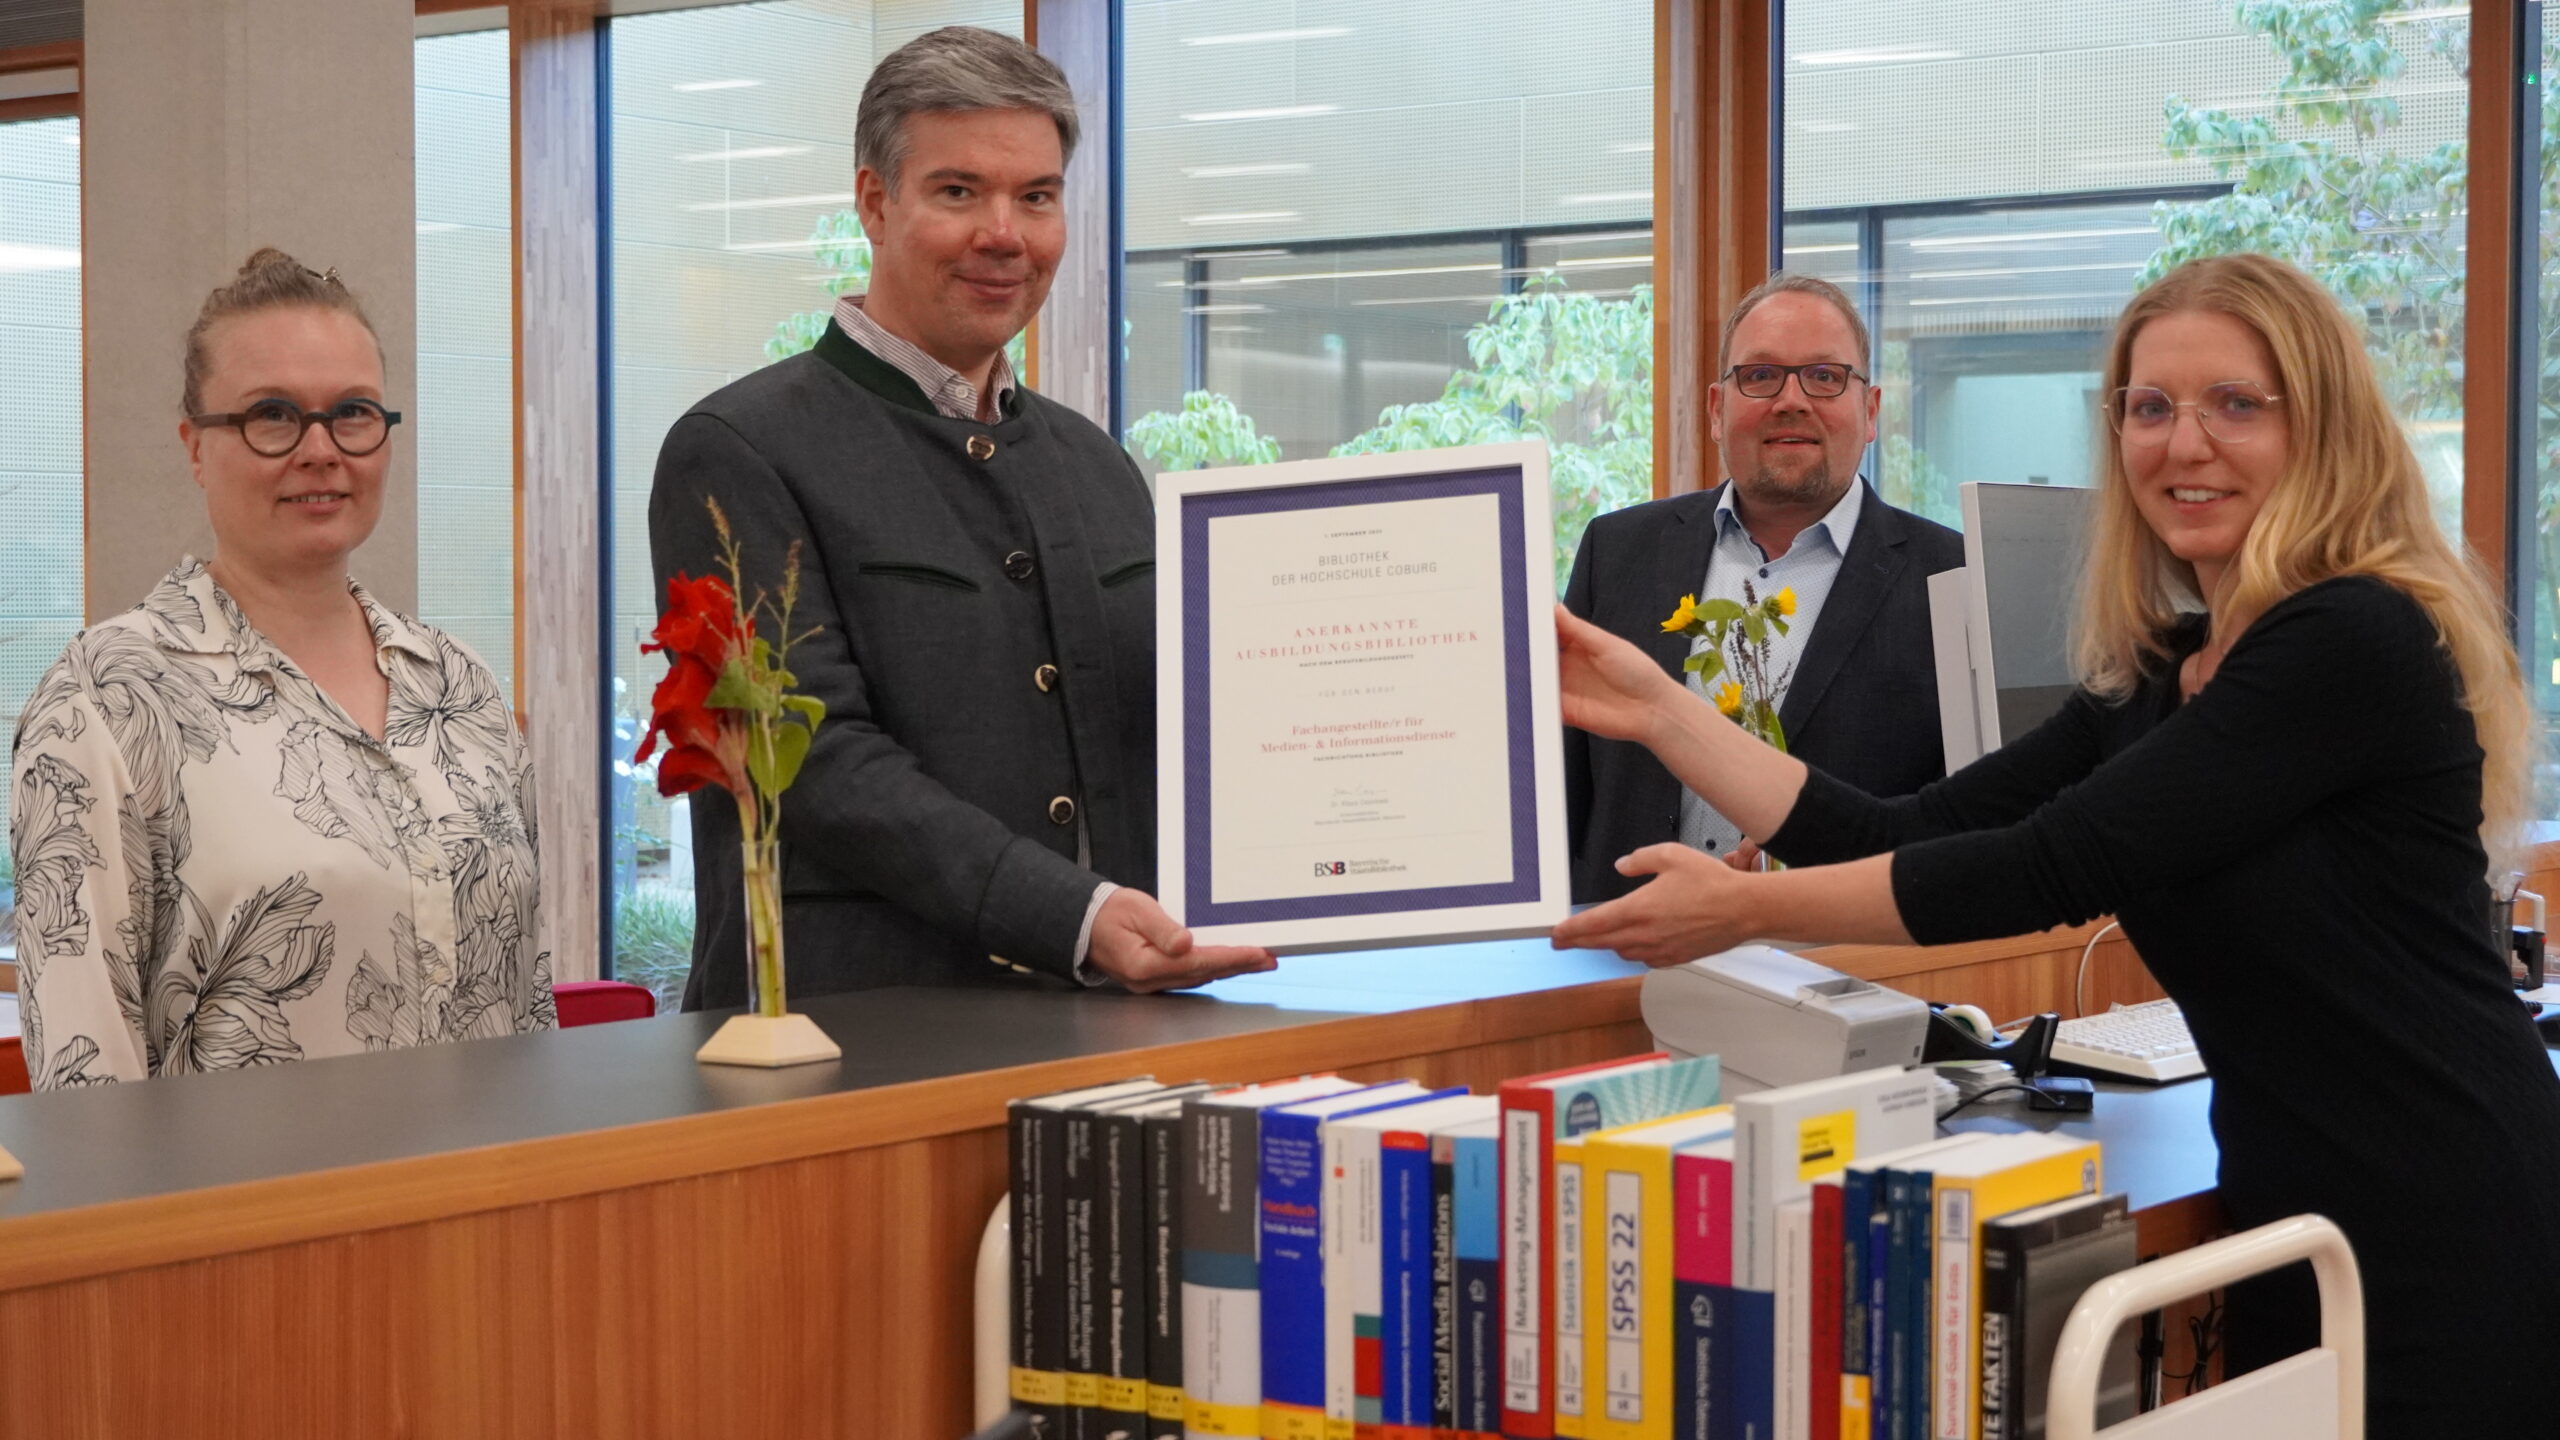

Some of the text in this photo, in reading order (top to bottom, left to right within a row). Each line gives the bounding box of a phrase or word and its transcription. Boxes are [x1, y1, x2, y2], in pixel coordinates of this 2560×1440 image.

[1318, 551, 1391, 567] BIBLIOTHEK
[1272, 562, 1438, 586] DER HOCHSCHULE COBURG
[1294, 618, 1420, 639] ANERKANNTE
[1234, 631, 1479, 660] AUSBILDUNGSBIBLIOTHEK
[1291, 716, 1425, 736] Fachangestellte/r für
[1261, 730, 1457, 754] Medien- & Informationsdienste
[1314, 861, 1346, 877] BSB
[1263, 1200, 1317, 1218] Handbuch
[1561, 1174, 1577, 1216] SPSS
[1514, 1120, 1532, 1328] Marketing-Management
[1561, 1223, 1577, 1252] mit
[1068, 1261, 1079, 1286] und
[1611, 1212, 1635, 1332] SPSS 22
[1432, 1193, 1451, 1412] Social Media Relations
[1561, 1258, 1577, 1331] Statistik
[1945, 1305, 1960, 1327] für
[1079, 1304, 1094, 1370] Bindungen
[1982, 1313, 2000, 1409] FAKTEN
[1945, 1332, 1960, 1436] Survival-Guide
